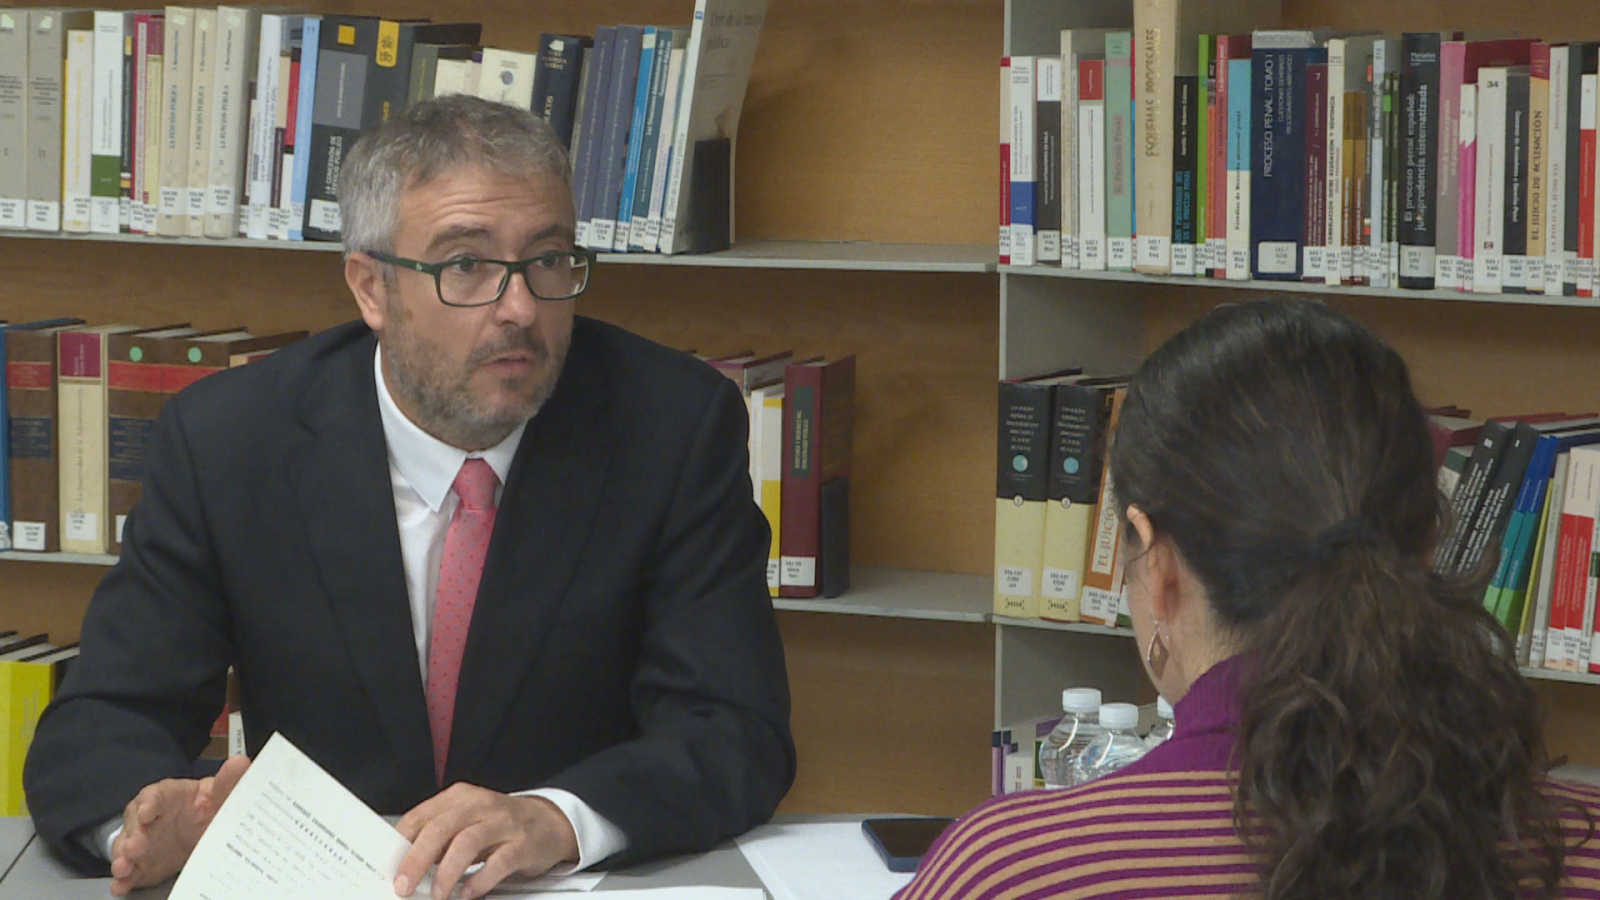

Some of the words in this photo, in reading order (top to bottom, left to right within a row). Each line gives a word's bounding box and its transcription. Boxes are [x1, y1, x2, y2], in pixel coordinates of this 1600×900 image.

[1264, 59, 1274, 92] TOMO
[1416, 84, 1428, 156] sistematizada
[1263, 130, 1274, 178] PROCESO
[1406, 138, 1417, 167] penal
[1406, 168, 1416, 209] proceso
[1532, 175, 1541, 190] DE
[1404, 211, 1413, 223] El
[1531, 192, 1541, 228] JUICIO
[1531, 230, 1540, 241] EL
